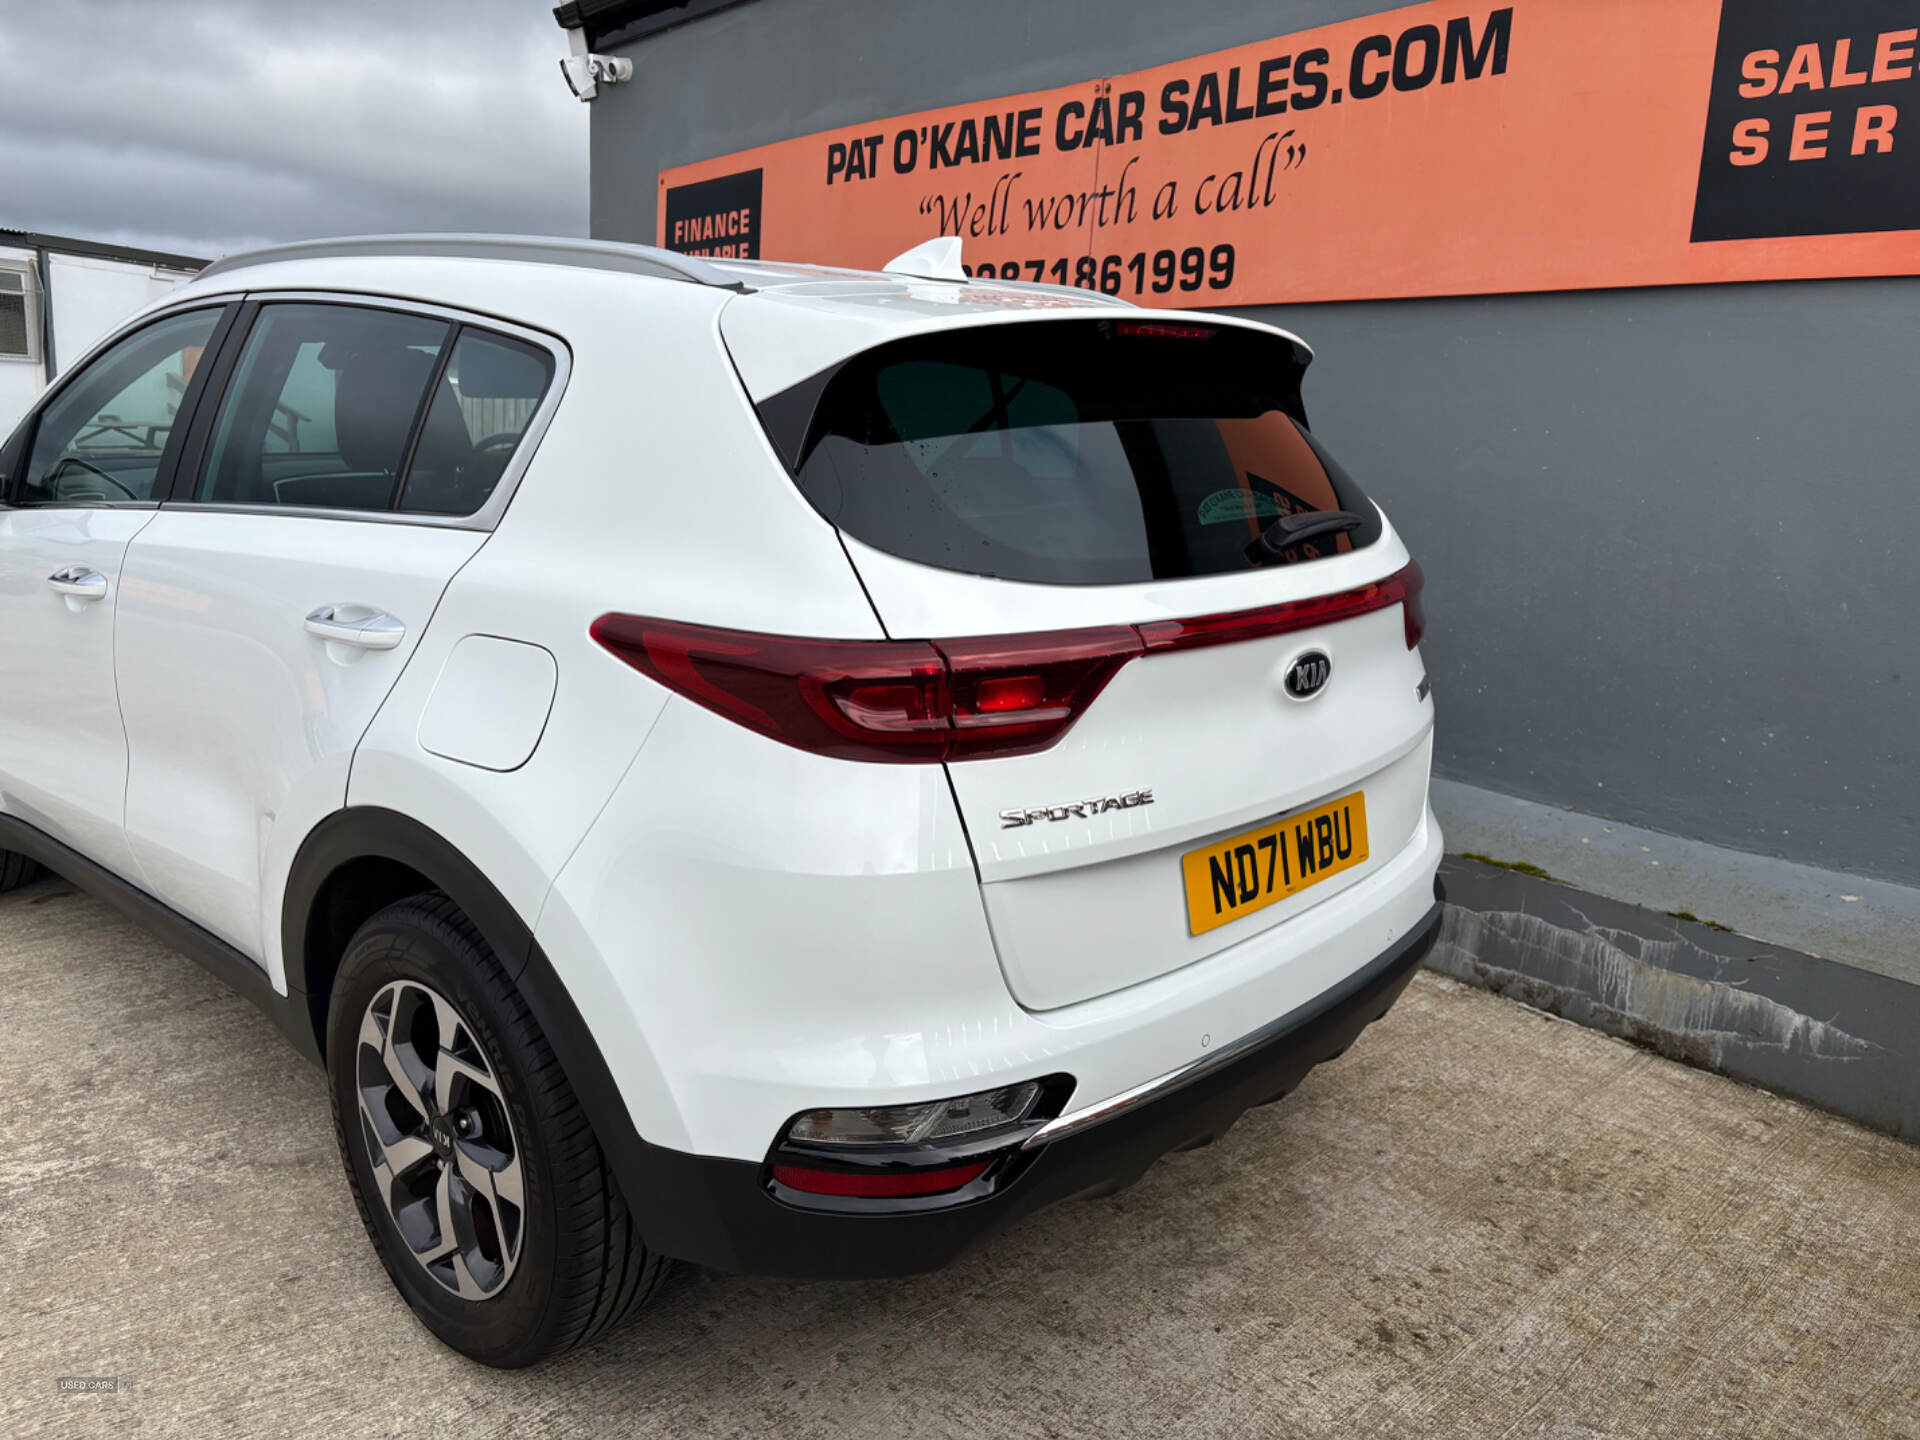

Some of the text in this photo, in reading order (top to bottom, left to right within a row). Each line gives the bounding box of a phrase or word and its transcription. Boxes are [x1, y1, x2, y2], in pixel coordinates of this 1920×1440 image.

[827, 7, 1514, 185] PAT O'KANE CAR SALES.COM
[1738, 28, 1920, 99] SALE
[674, 208, 750, 244] FINANCE
[1023, 156, 1140, 232] worth
[1152, 179, 1178, 221] a
[1295, 660, 1327, 691] KIA
[999, 789, 1155, 829] SPORTAGE
[1209, 806, 1352, 915] ND71 WBU
